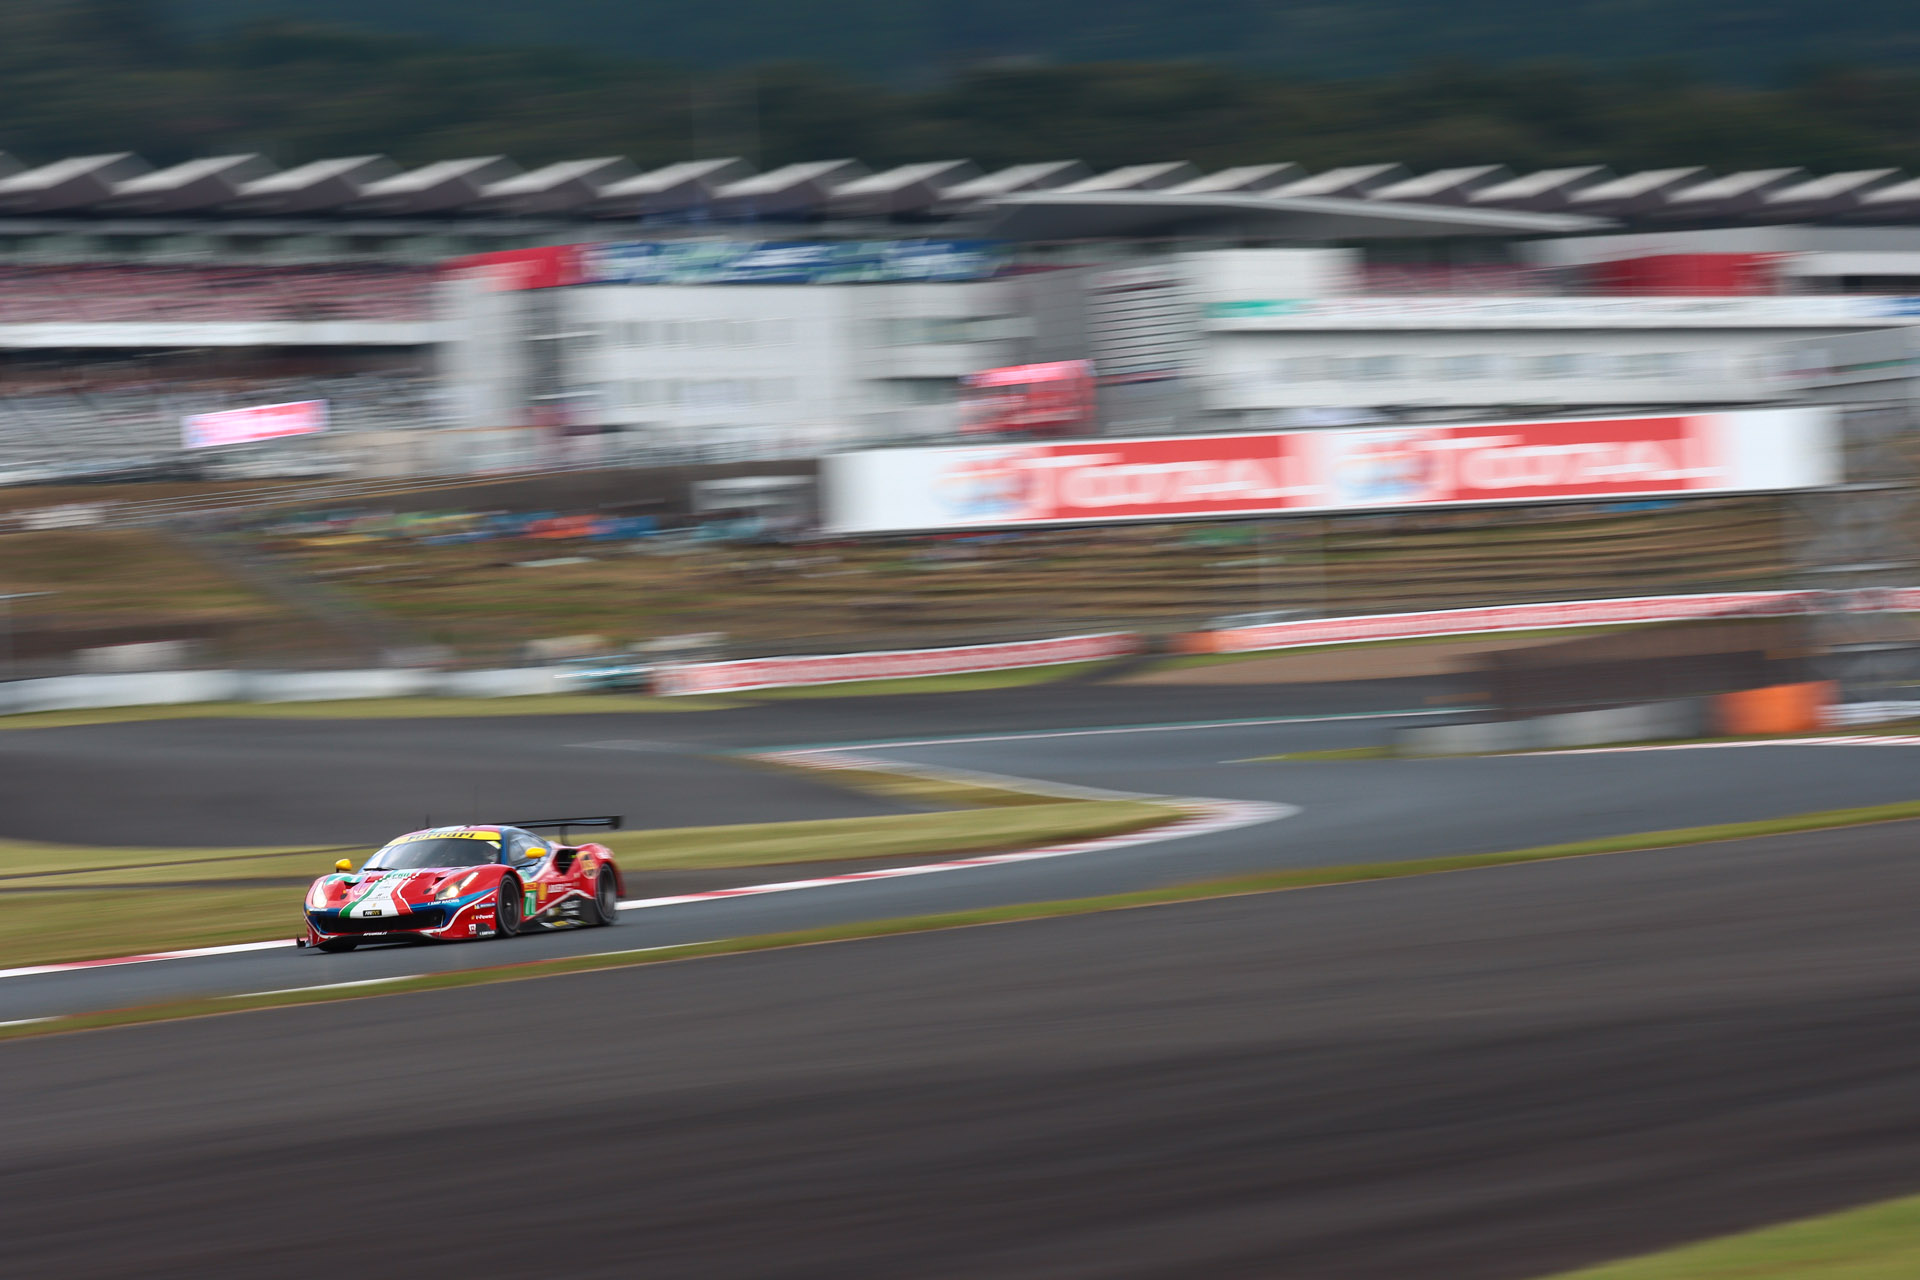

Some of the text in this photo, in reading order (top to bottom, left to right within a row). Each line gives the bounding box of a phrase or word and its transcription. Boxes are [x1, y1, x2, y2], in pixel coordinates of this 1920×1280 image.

[1010, 452, 1324, 509] TOTAL
[1408, 433, 1728, 490] TOTAL
[407, 830, 476, 841] Ferrari
